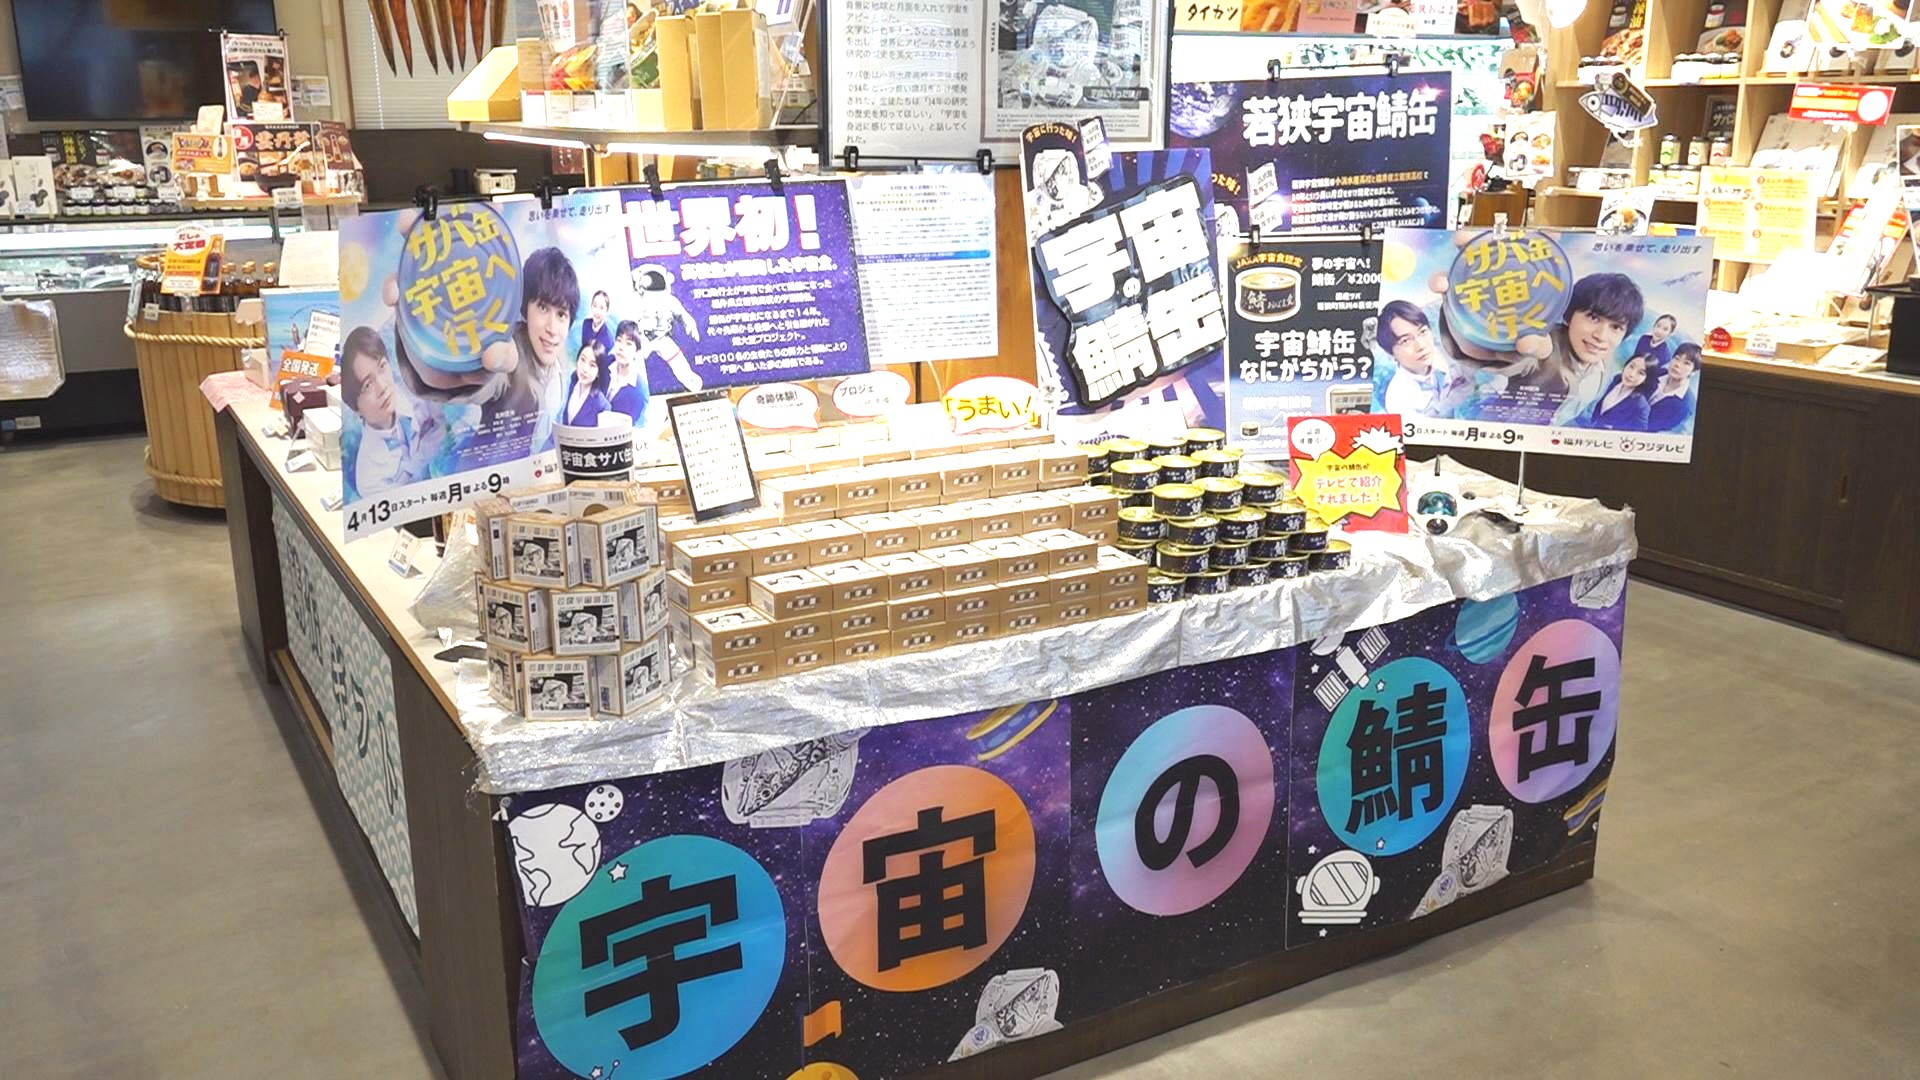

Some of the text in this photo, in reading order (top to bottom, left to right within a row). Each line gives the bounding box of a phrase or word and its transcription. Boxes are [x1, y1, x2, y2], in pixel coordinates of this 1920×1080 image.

[1187, 4, 1238, 21] タイカツ
[1242, 89, 1438, 147] 若狭宇宙鯖缶
[1040, 181, 1210, 315] 宇宙
[1592, 242, 1703, 256] 思いを乗せて、走り出す
[404, 254, 517, 326] 宇宙へ
[1455, 270, 1565, 313] 宇宙へ
[442, 301, 509, 357] 行く
[1072, 271, 1228, 402] 鯖缶
[1486, 303, 1547, 340] 行く
[1254, 327, 1357, 358] 宇宙鯖缶
[1563, 437, 1686, 454] 福井テレビ フジテレビ
[1316, 475, 1382, 488] テレビで紹介
